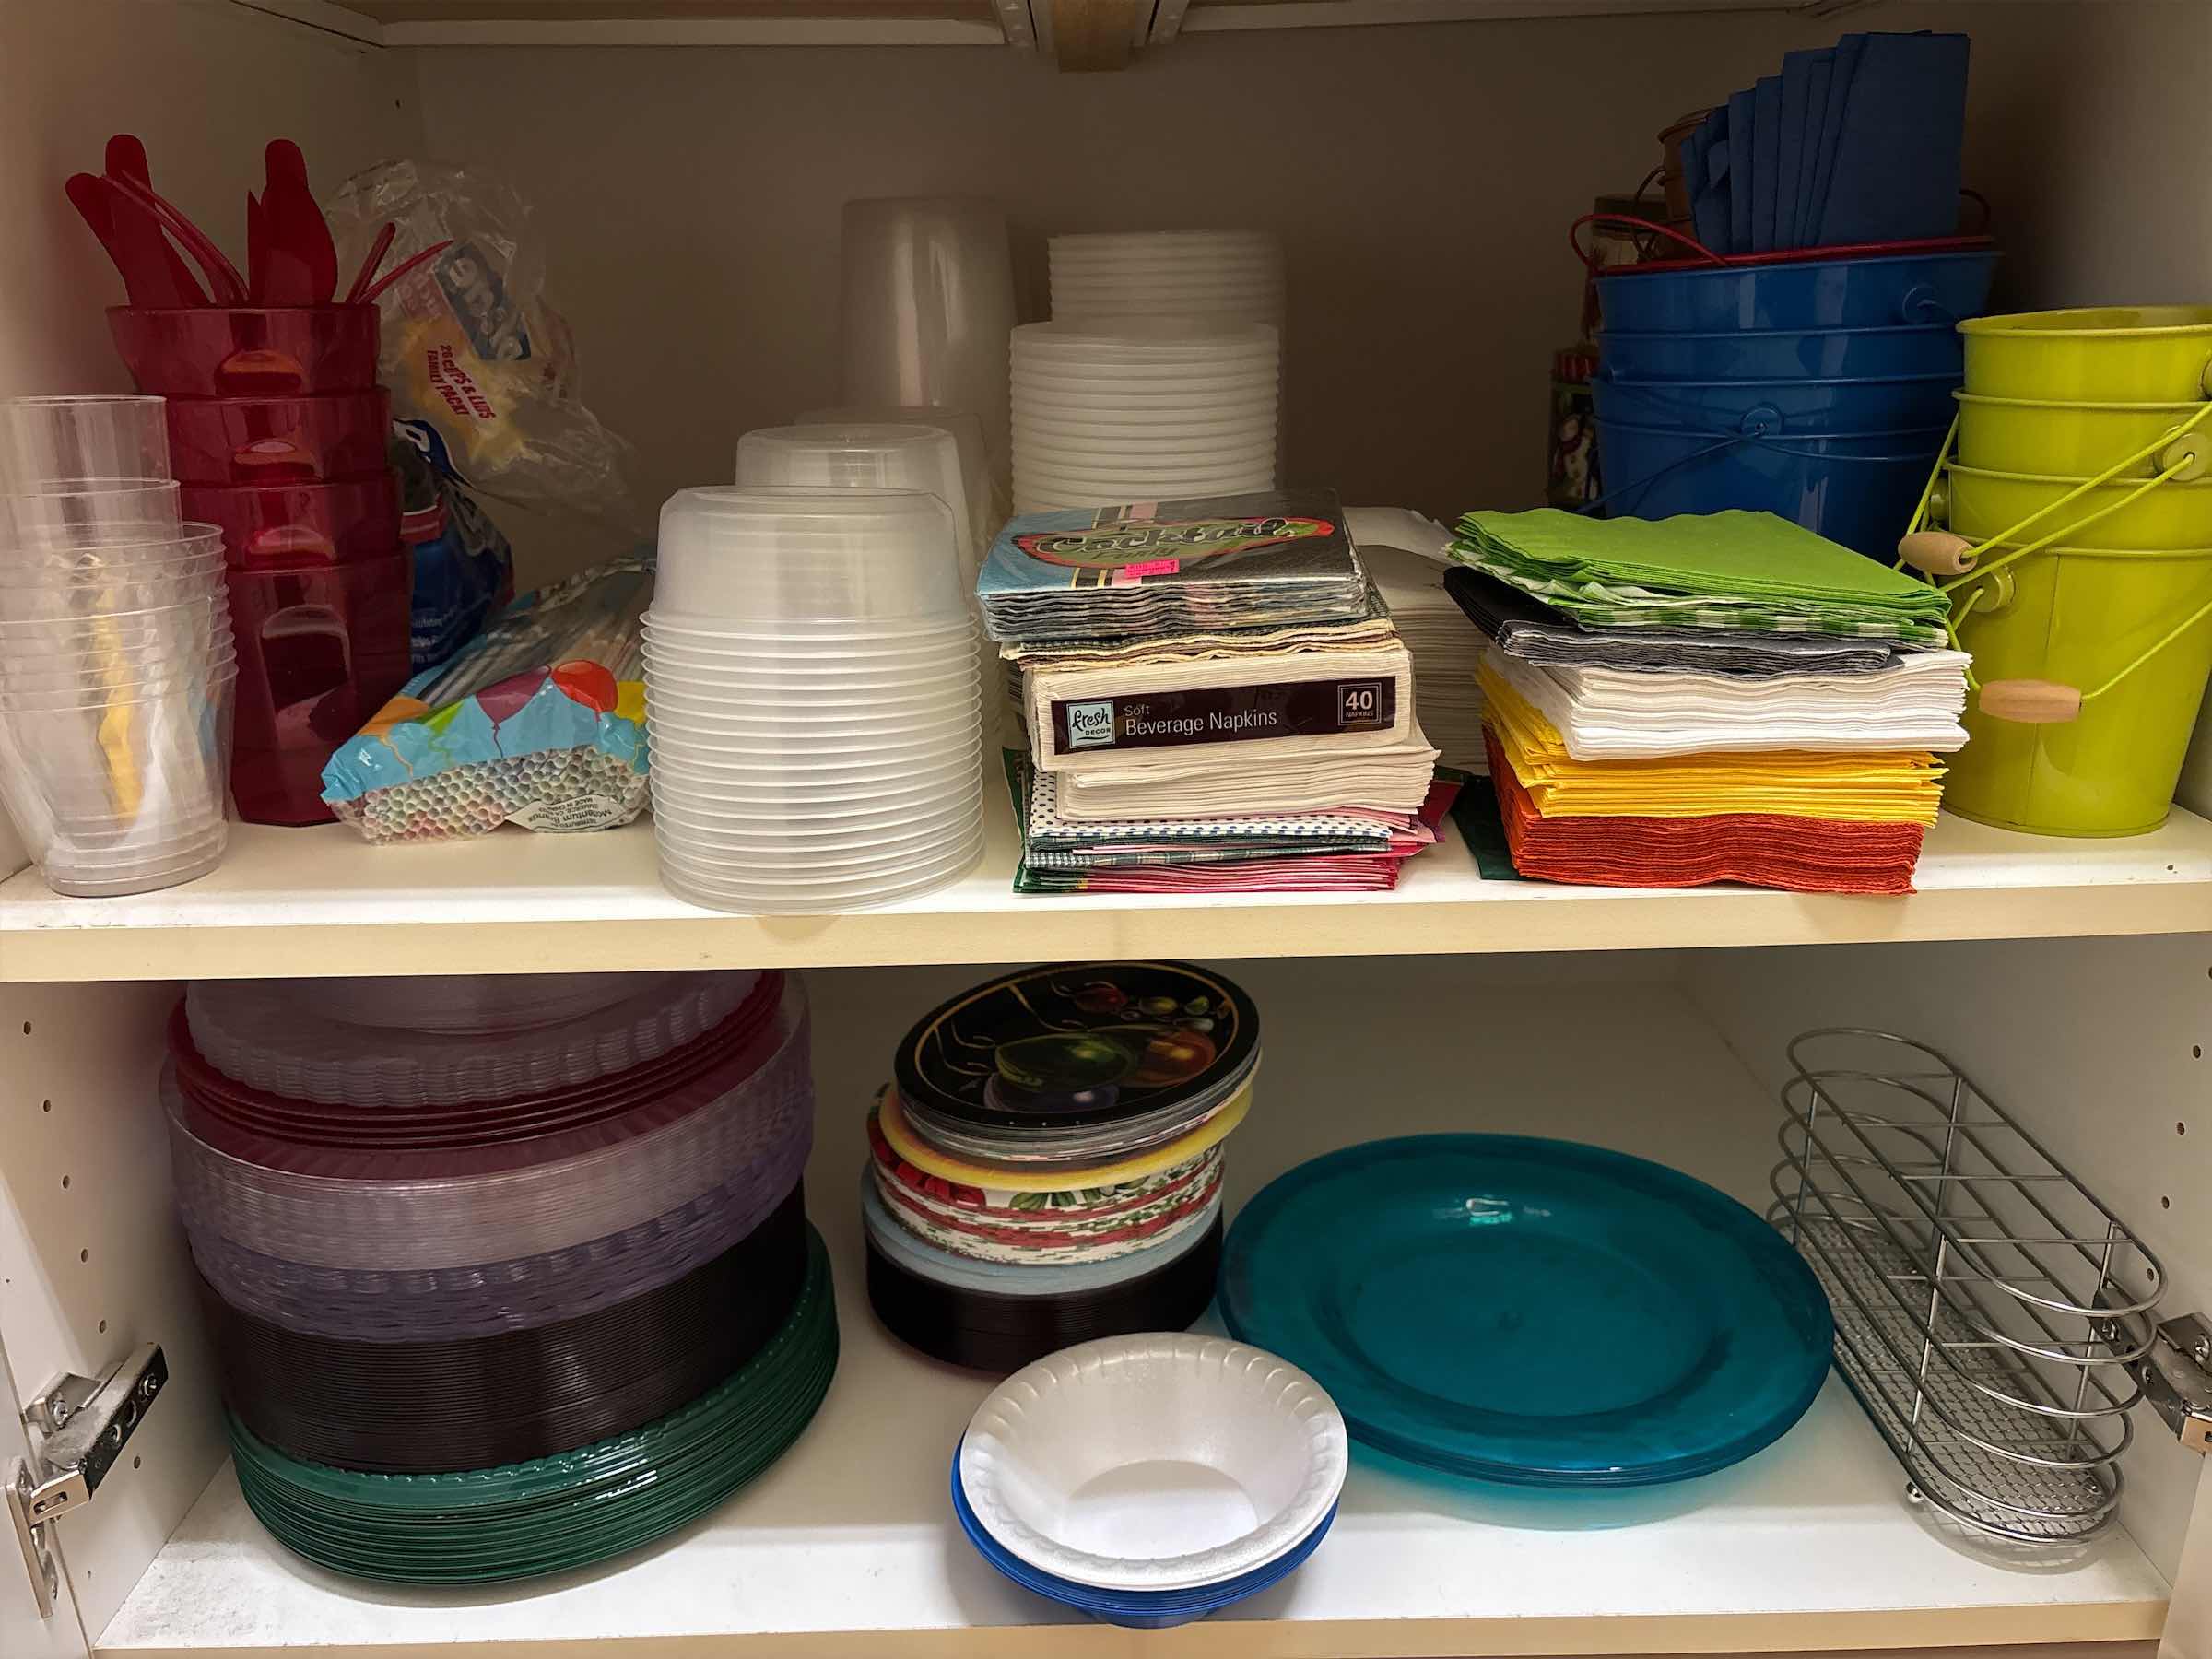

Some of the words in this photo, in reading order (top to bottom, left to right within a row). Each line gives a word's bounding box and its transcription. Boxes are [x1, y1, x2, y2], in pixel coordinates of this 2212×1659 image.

[427, 350, 446, 383] FAMILY
[442, 359, 472, 385] CUPS
[467, 394, 496, 418] LIDS
[1124, 703, 1150, 717] Soft
[1346, 690, 1373, 710] 40
[1071, 705, 1112, 731] fresh
[1125, 714, 1204, 736] Beverage
[1209, 709, 1277, 731] Napkins
[1346, 710, 1374, 718] NAPKINS
[1086, 727, 1111, 735] DECOR
